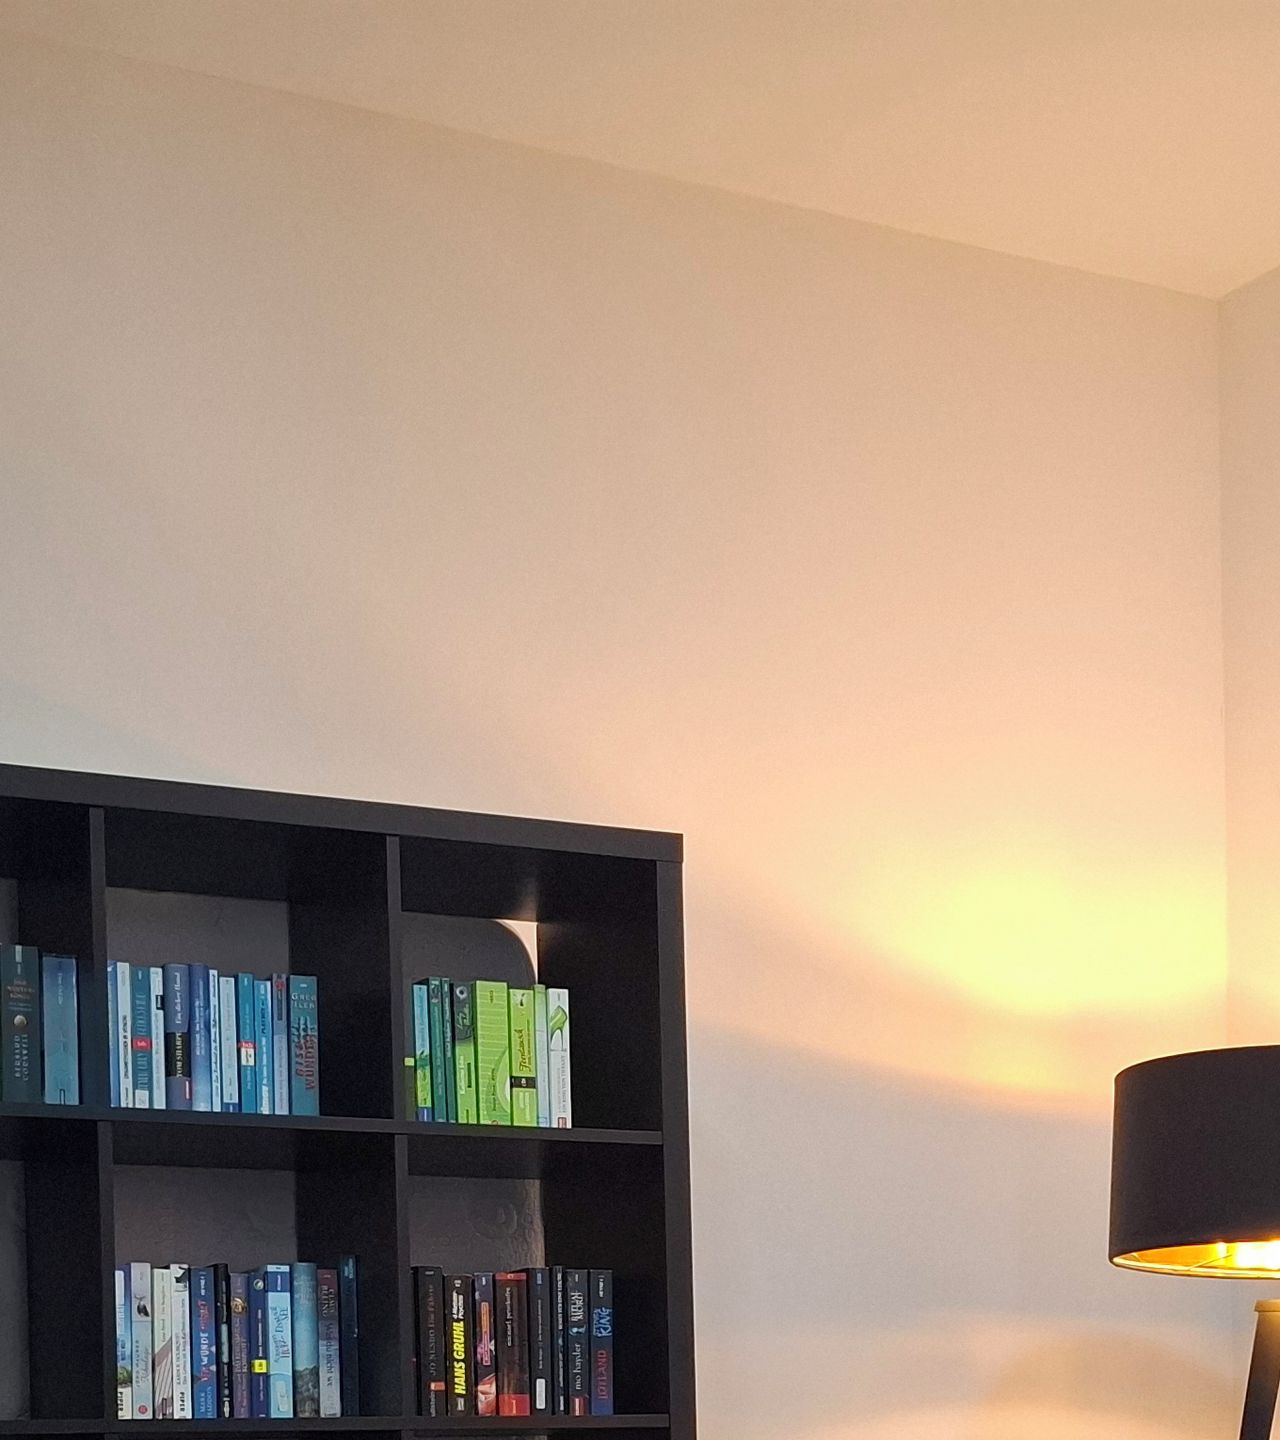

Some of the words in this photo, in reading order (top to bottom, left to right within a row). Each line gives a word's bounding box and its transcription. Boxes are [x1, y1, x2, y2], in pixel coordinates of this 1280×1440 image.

[600, 1307, 612, 1338] KING
[453, 1321, 465, 1360] GRUHL
[572, 1343, 583, 1373] hayder
[454, 1362, 466, 1394] HANS
[575, 1374, 582, 1390] mo
